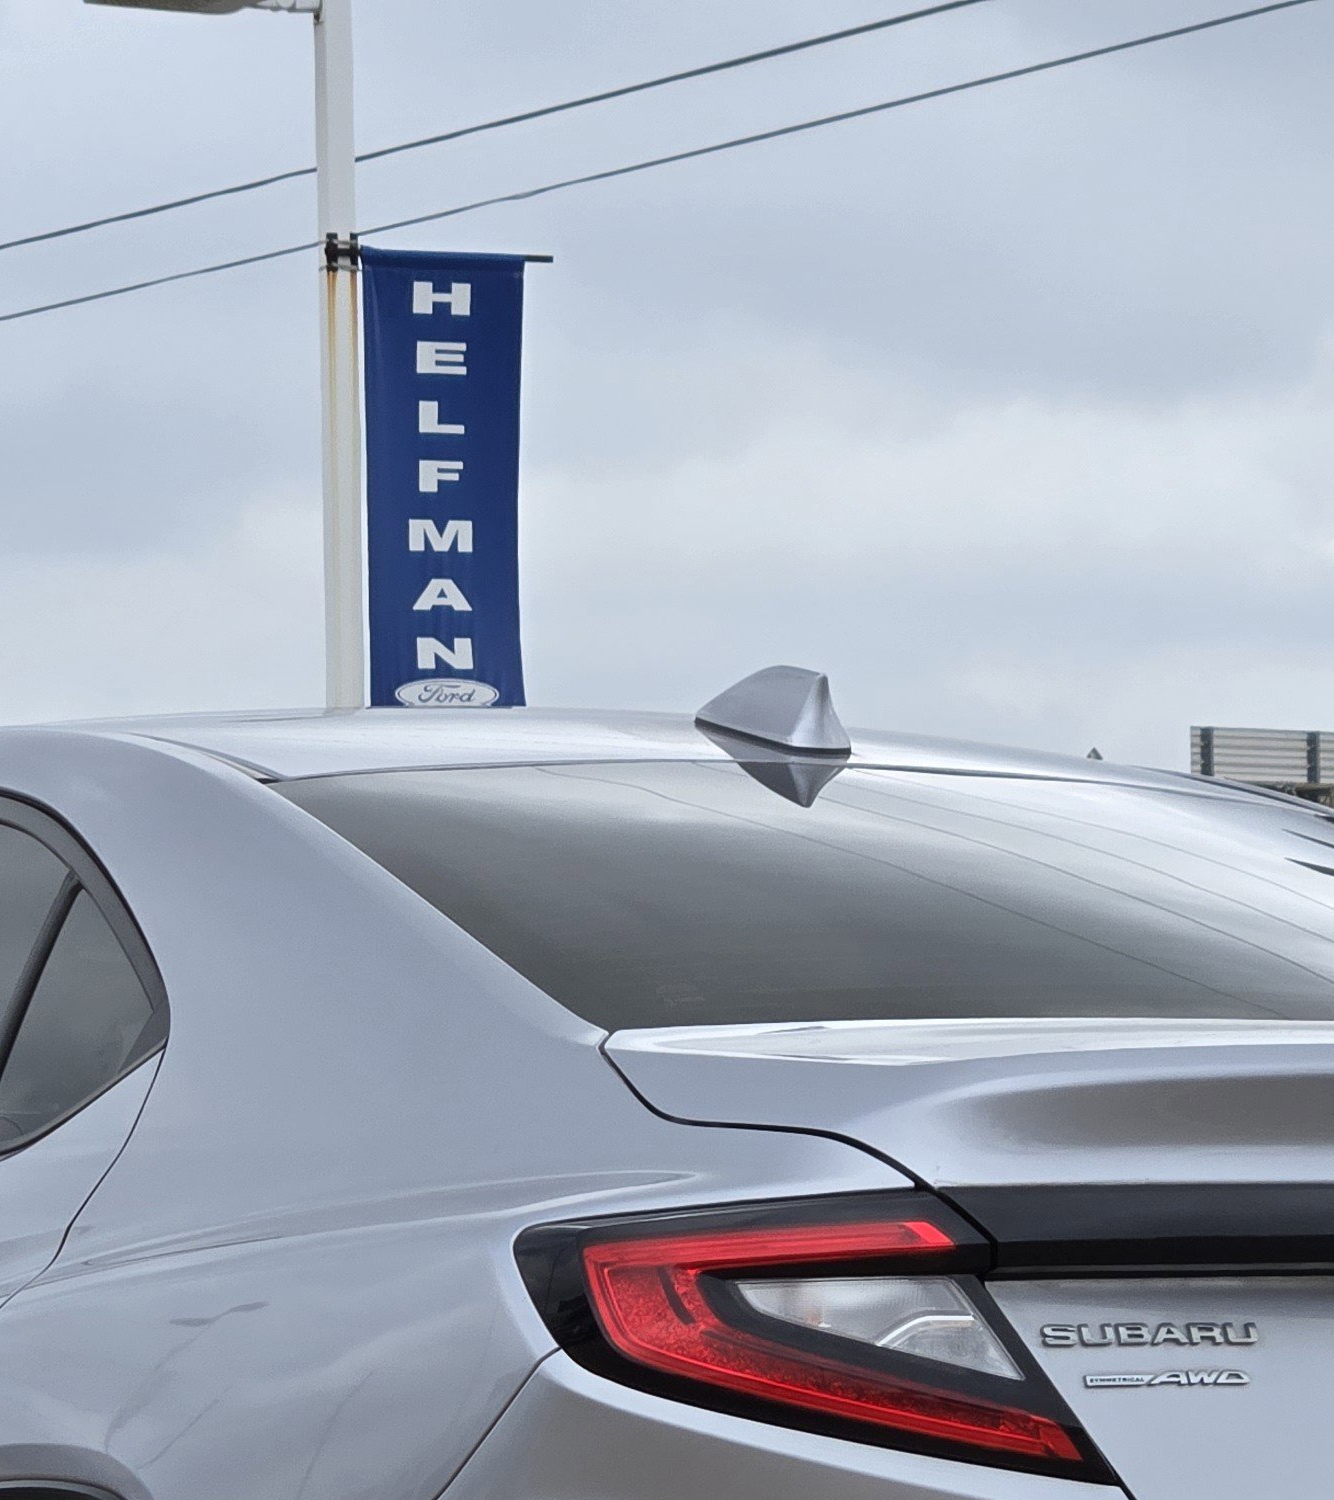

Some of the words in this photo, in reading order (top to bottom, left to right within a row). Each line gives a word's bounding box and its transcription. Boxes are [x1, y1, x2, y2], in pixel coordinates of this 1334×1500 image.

[408, 280, 474, 670] HELFMAN
[416, 682, 477, 705] Ford
[1040, 1321, 1260, 1347] SUBARU
[1149, 1369, 1252, 1387] AWD
